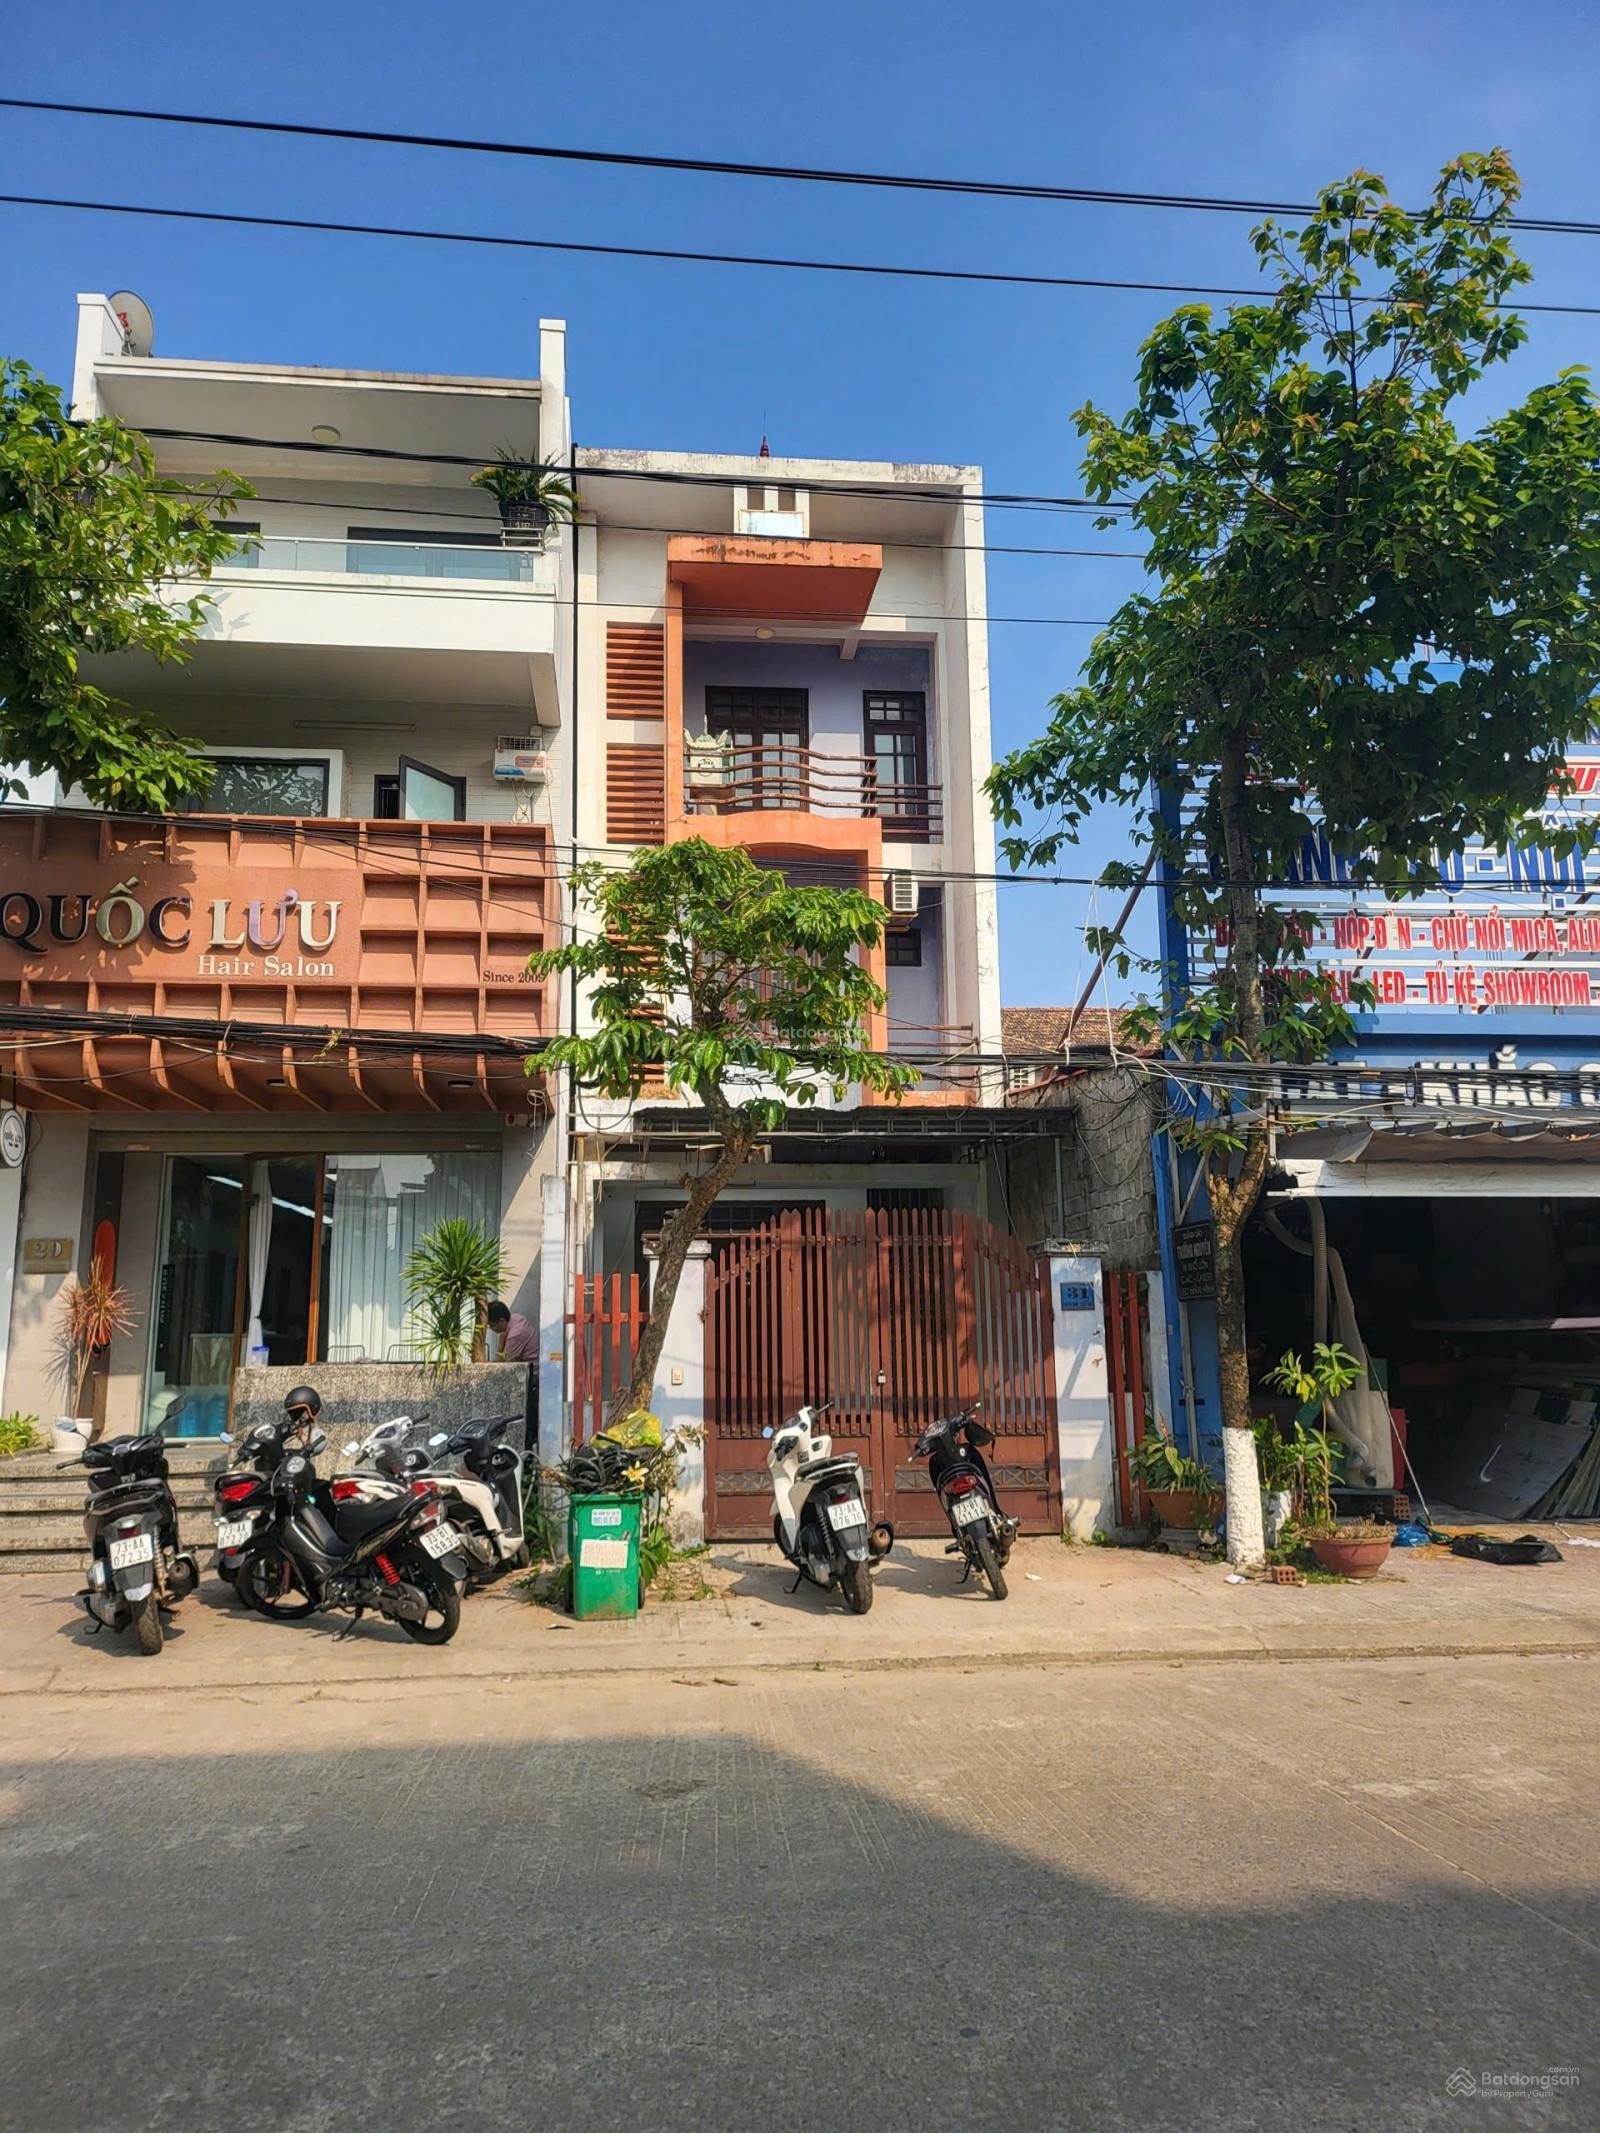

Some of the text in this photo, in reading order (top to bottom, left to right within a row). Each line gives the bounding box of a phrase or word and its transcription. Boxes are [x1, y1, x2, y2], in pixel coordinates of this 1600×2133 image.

[0, 876, 343, 954] QUỐC LƯU
[1432, 911, 1469, 951] CHỮ
[1474, 905, 1506, 951] NỔI
[1511, 918, 1564, 955] MICA,
[197, 955, 334, 977] Hair Salon
[482, 969, 515, 983] Since
[1425, 960, 1448, 1004] TỦ
[1454, 965, 1478, 1010] KỆ
[1483, 970, 1590, 1005] SHOWROOM
[116, 1537, 144, 1555] 73-AA
